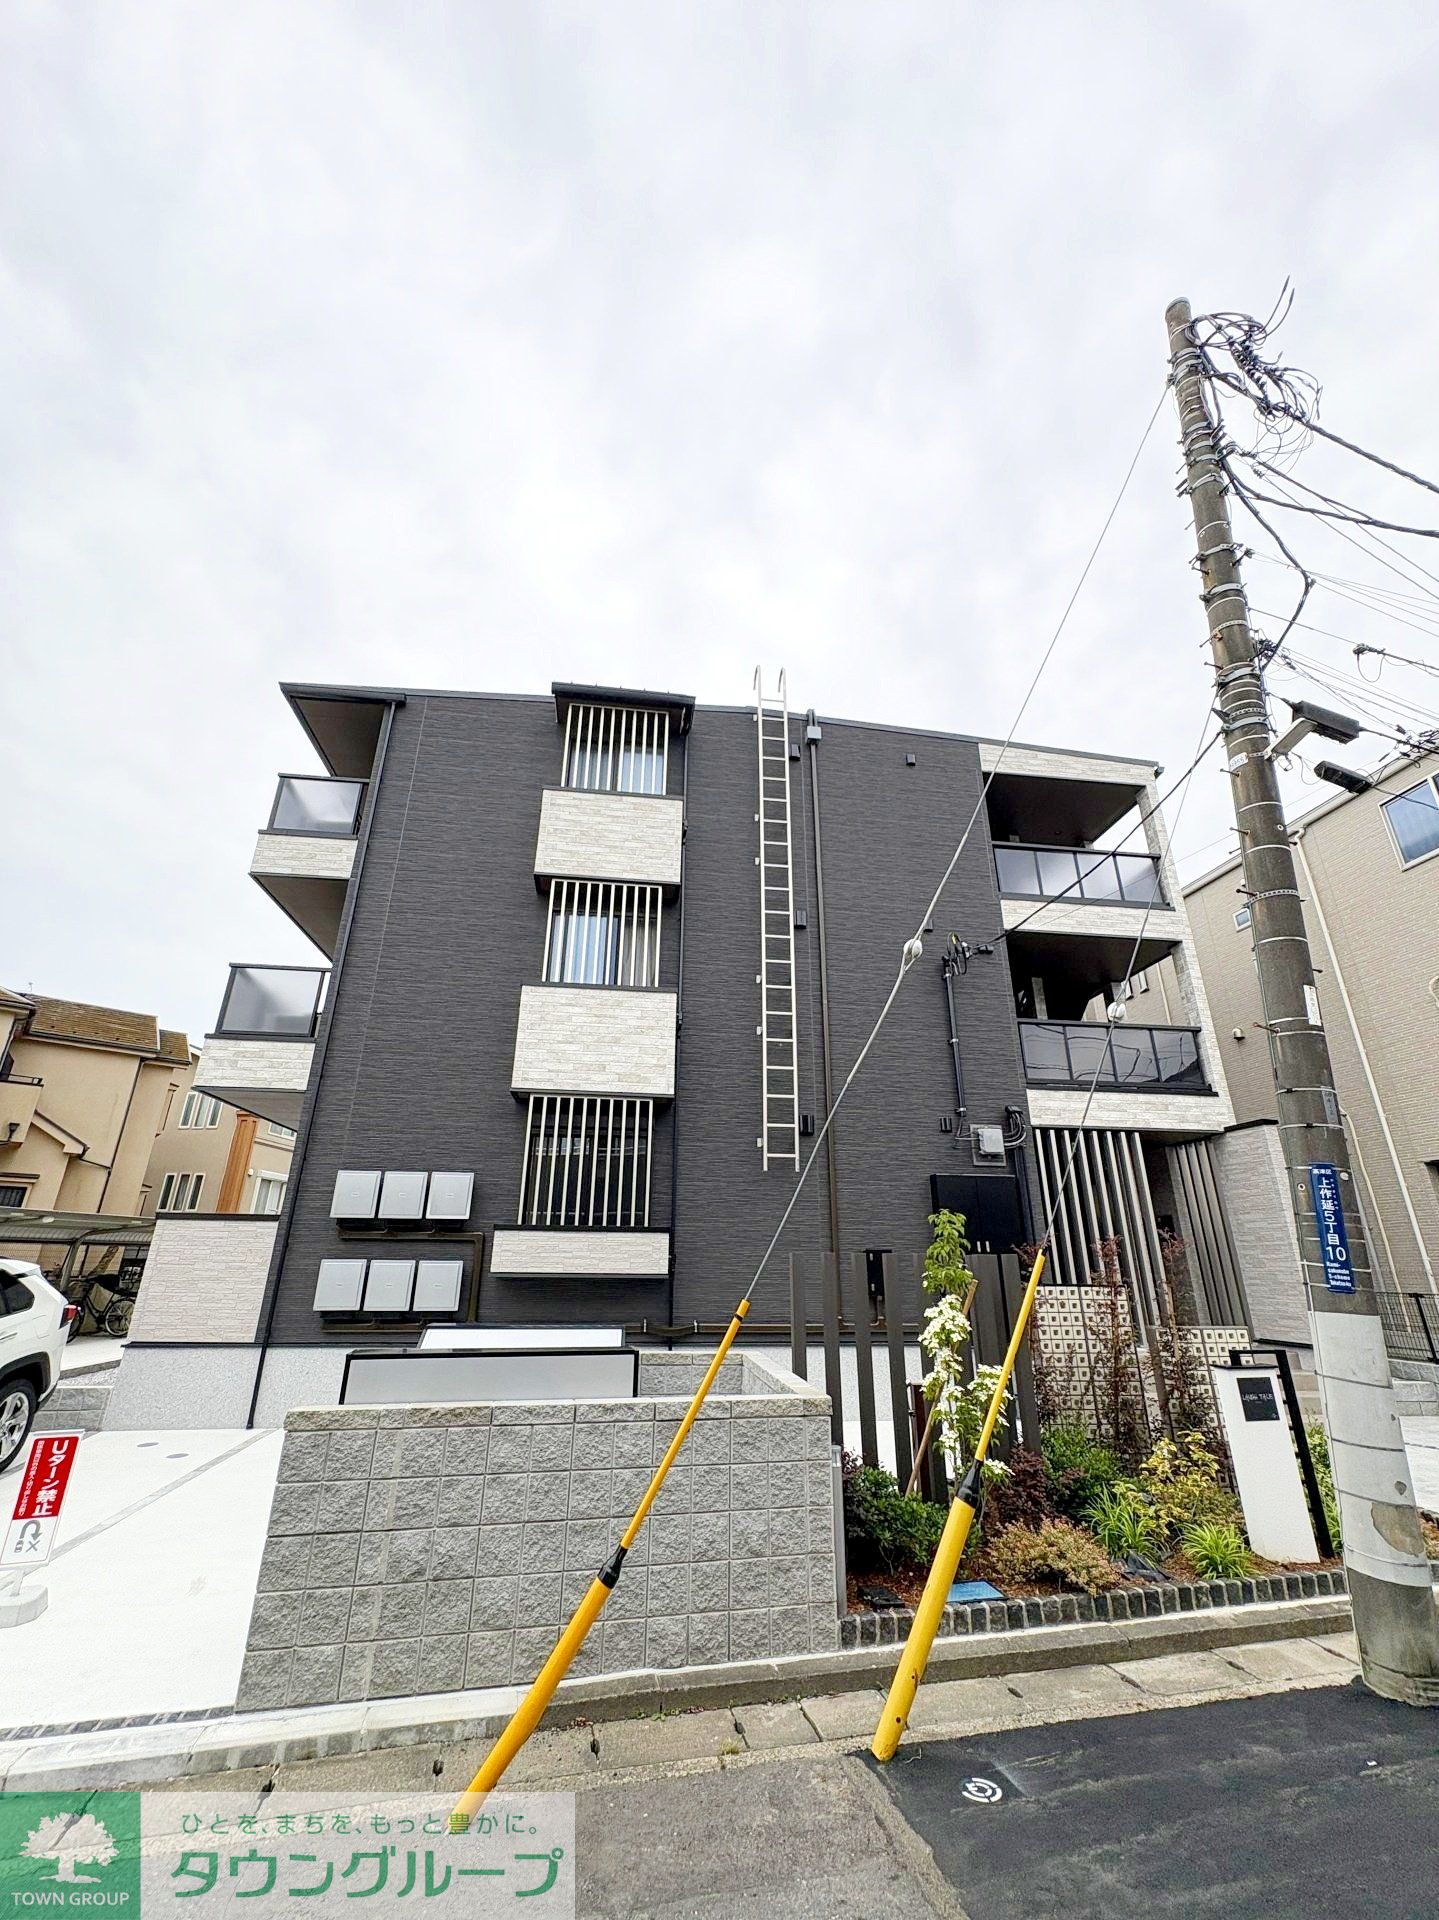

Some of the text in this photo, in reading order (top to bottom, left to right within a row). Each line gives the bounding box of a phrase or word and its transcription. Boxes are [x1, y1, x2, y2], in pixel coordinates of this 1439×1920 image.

[32, 1439, 69, 1516] Uターン禁止
